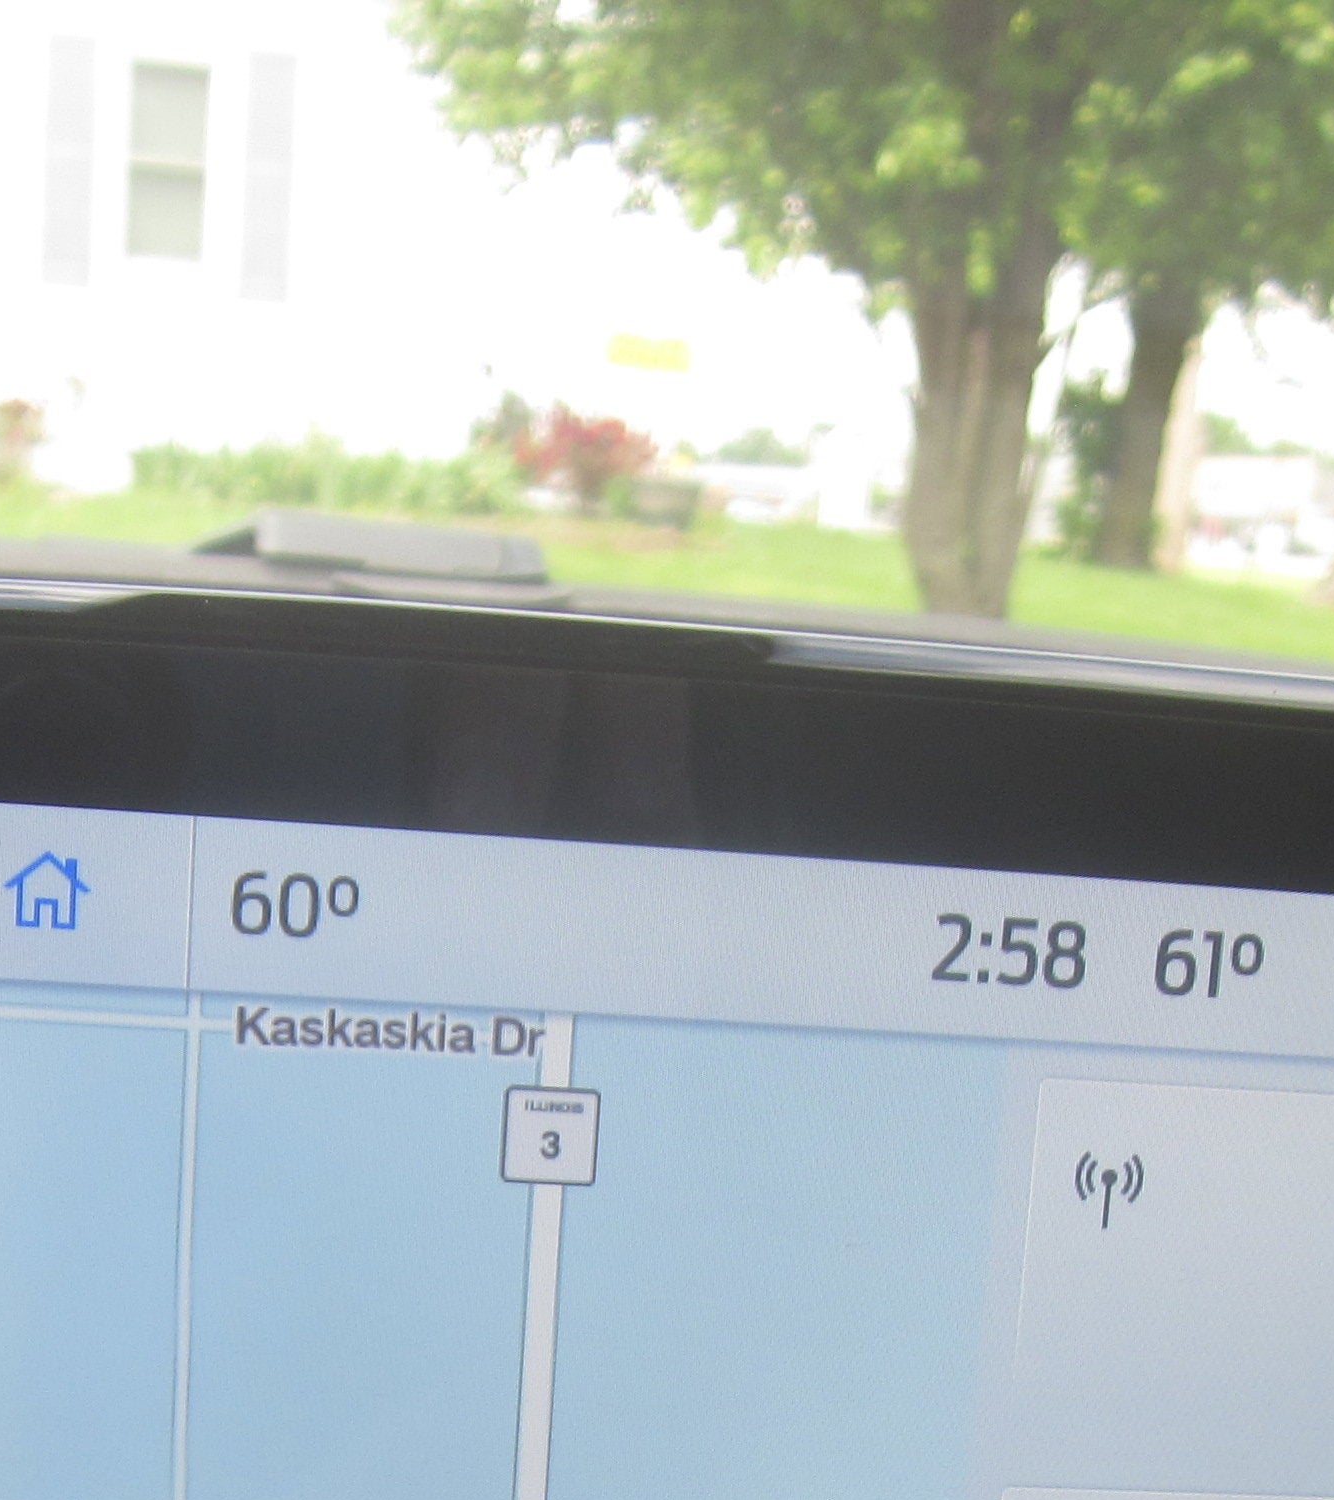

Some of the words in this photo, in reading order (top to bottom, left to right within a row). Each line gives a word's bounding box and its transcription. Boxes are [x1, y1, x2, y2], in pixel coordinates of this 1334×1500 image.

[232, 870, 359, 937] 60°
[930, 912, 1088, 988] 2:58
[1154, 928, 1265, 998] 61°
[236, 1006, 476, 1055] Kaskaskia
[492, 1015, 543, 1058] Dr
[540, 1130, 561, 1160] 3
